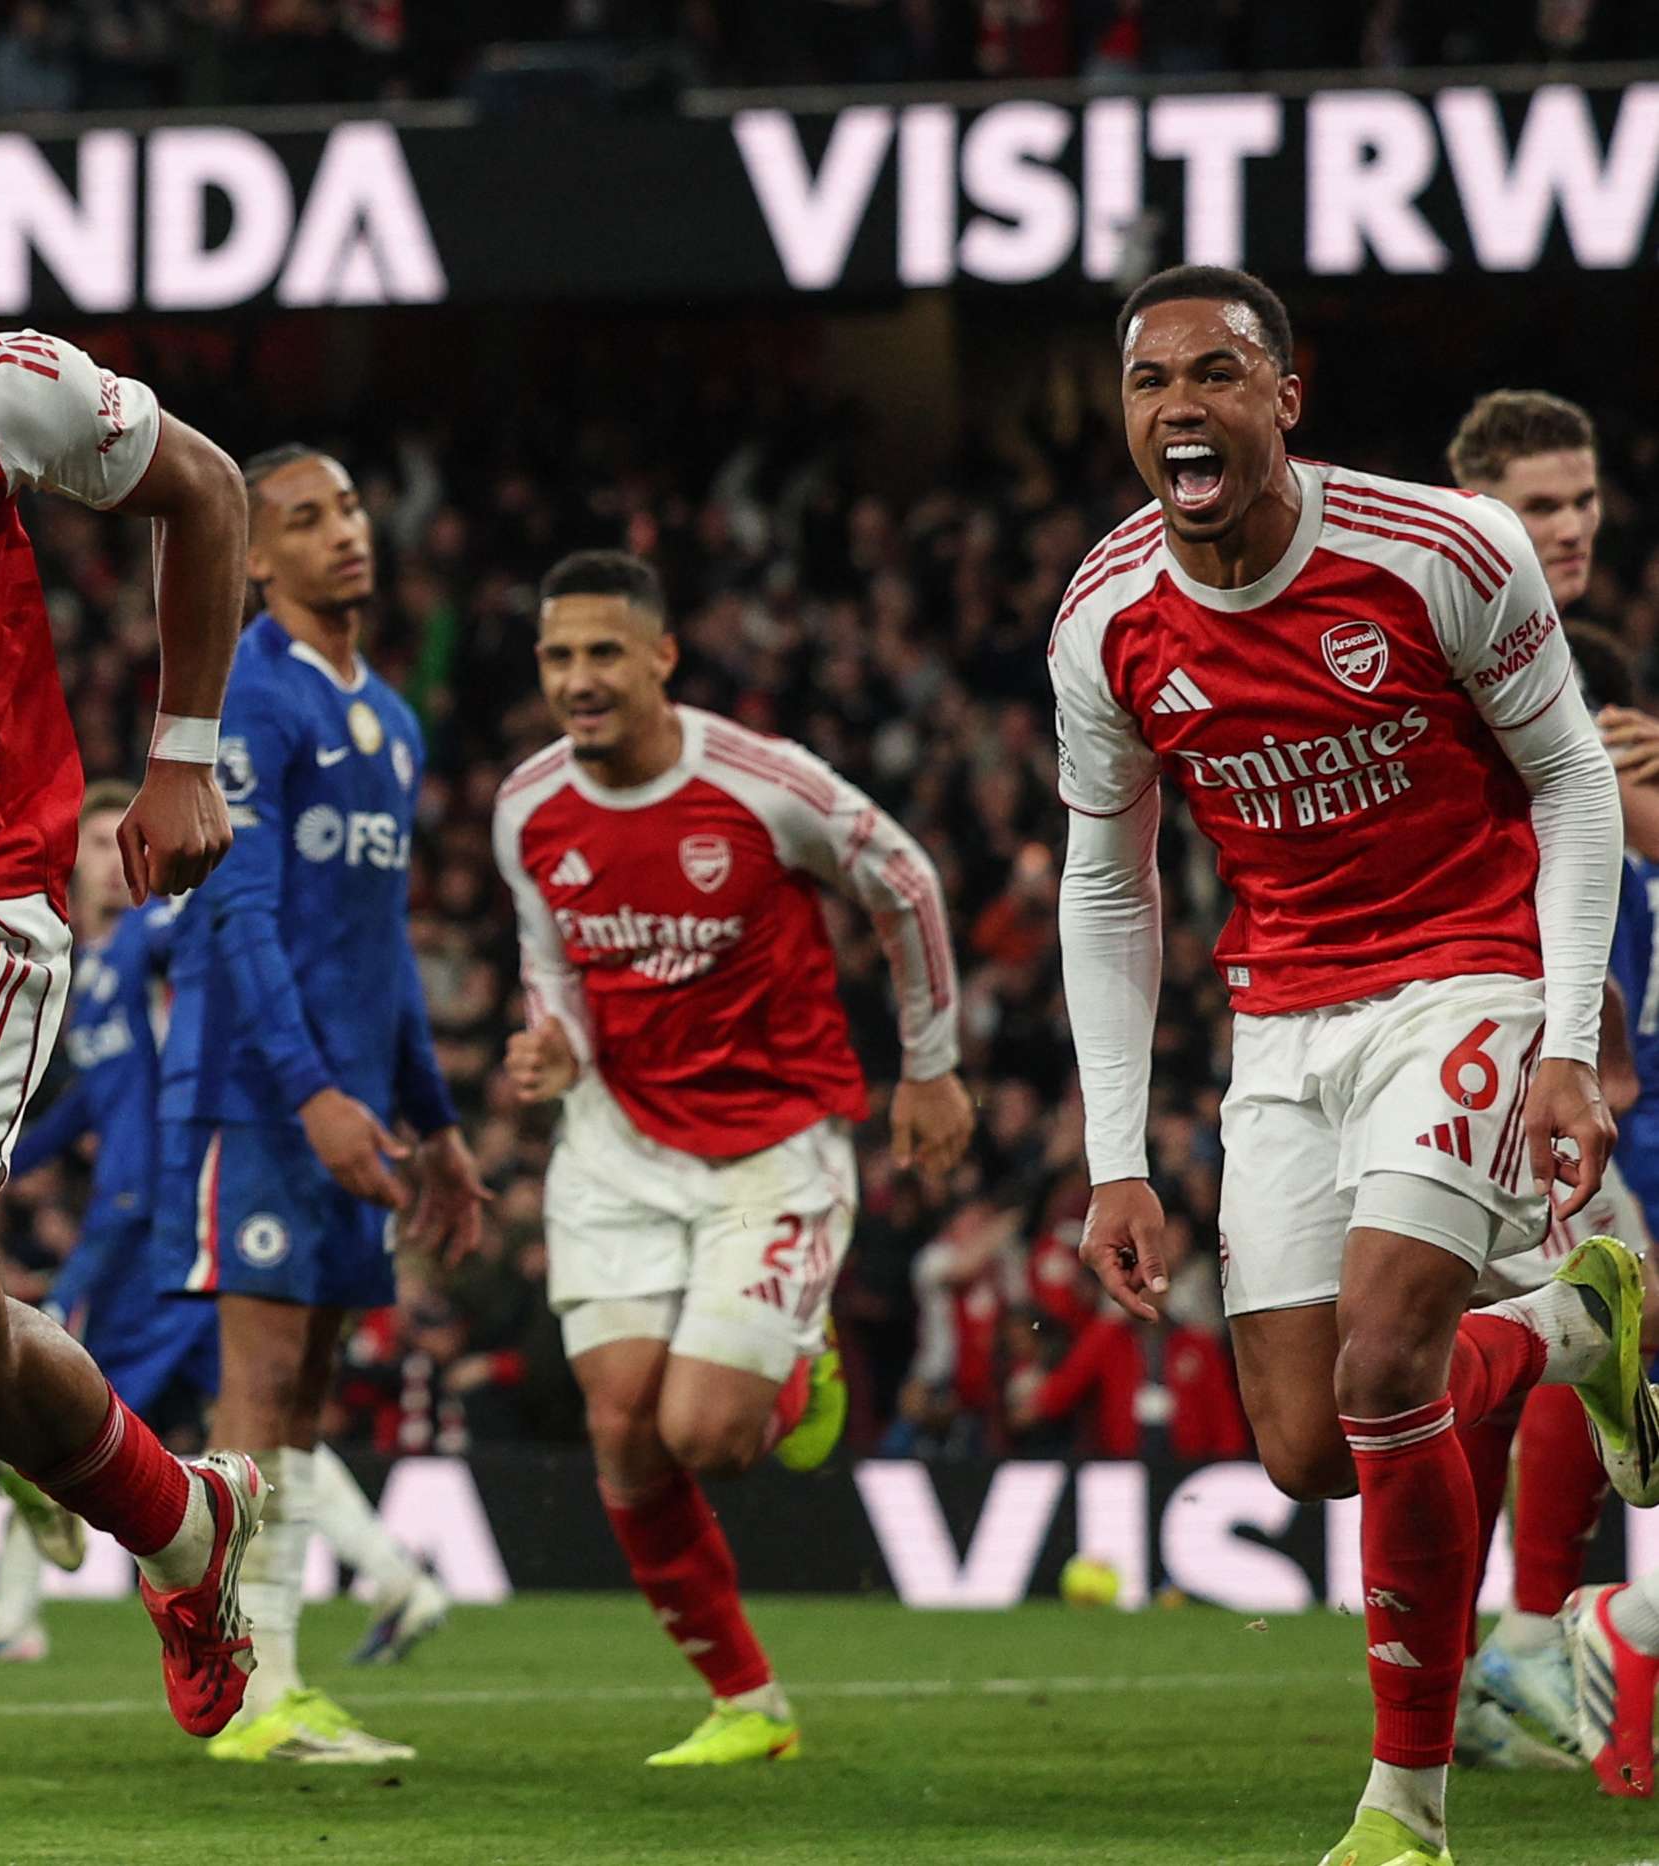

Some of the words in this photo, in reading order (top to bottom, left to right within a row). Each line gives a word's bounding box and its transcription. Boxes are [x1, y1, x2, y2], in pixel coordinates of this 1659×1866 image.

[730, 93, 1284, 290] VISIT
[1491, 609, 1541, 657] VISIT
[1173, 704, 1429, 790] Emirates
[1233, 792, 1282, 830] FLY
[1293, 760, 1412, 828] BETTER
[1439, 1018, 1501, 1111] 6
[852, 1459, 1518, 1614] VISI
